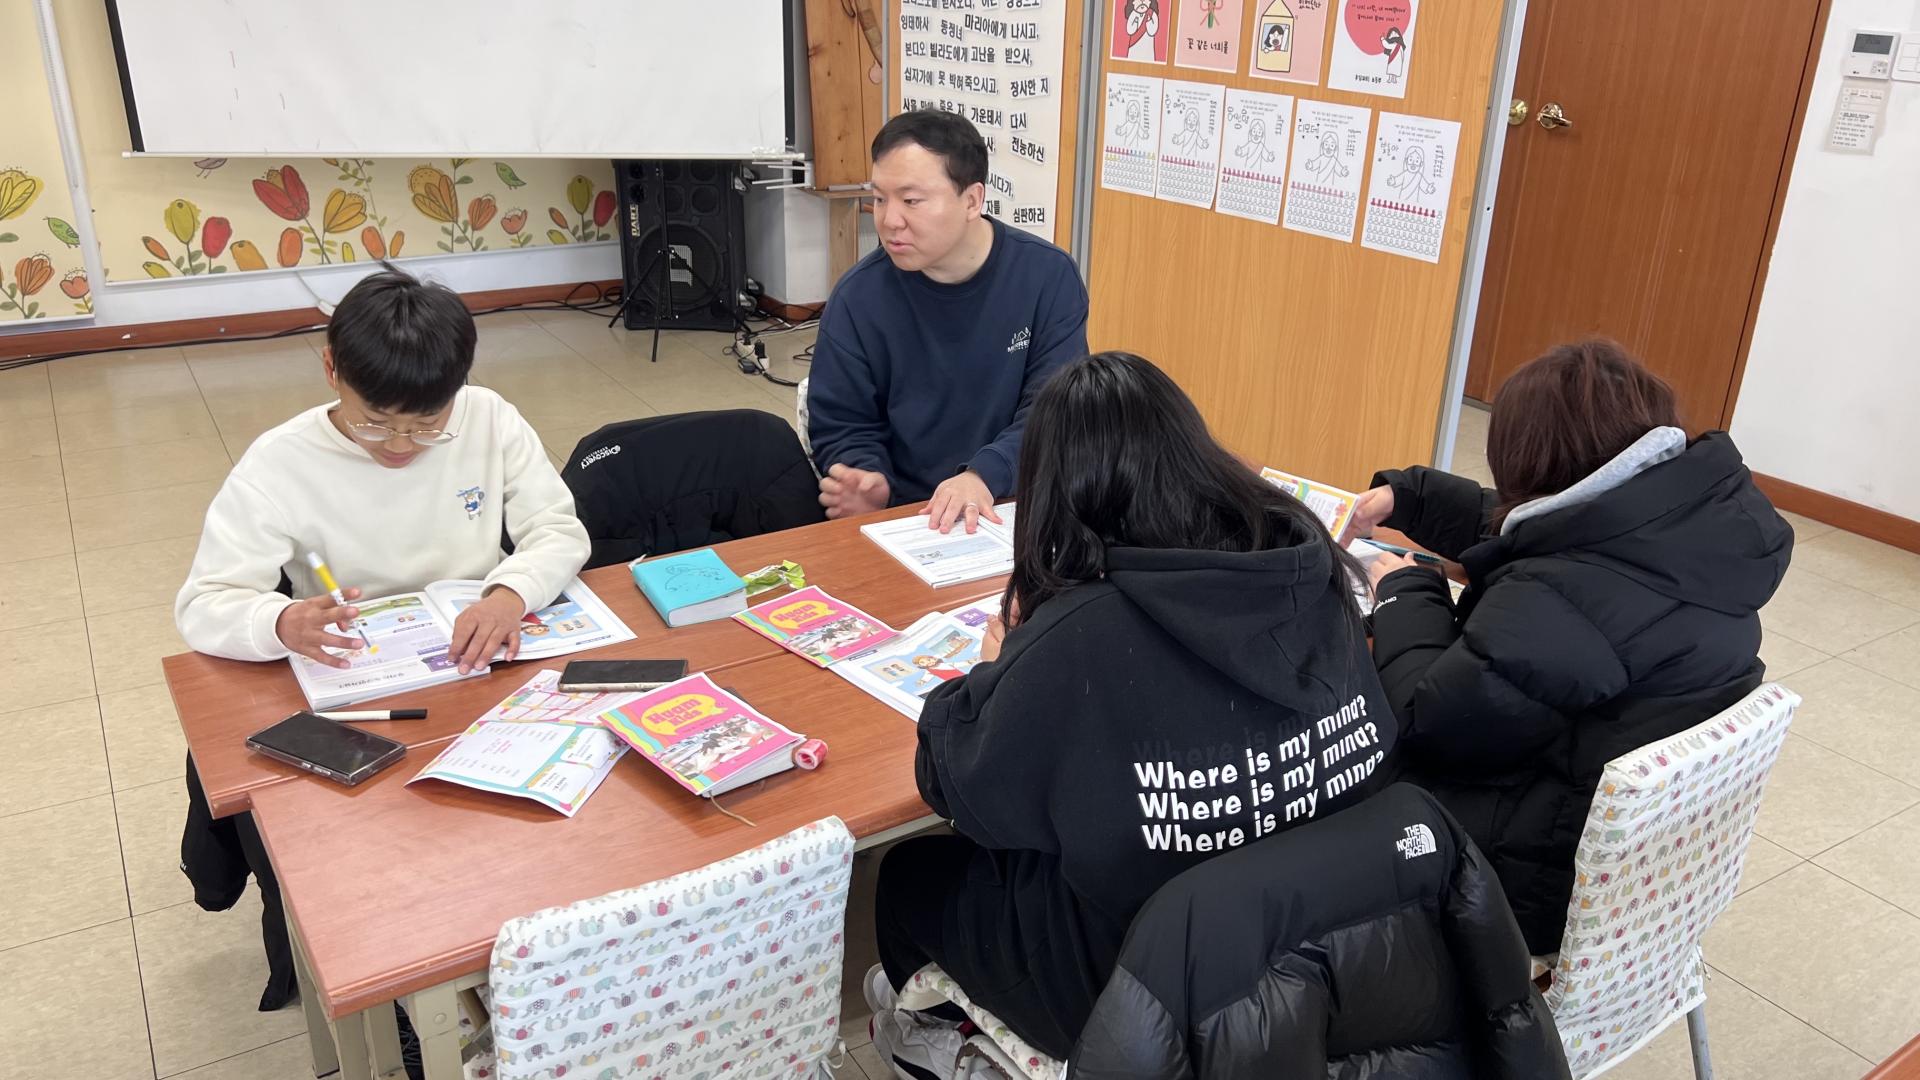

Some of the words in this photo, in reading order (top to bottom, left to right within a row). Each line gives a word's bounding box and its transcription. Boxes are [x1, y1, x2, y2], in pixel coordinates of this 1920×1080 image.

[940, 19, 963, 41] 동정녀
[964, 13, 1007, 39] 마리아에게
[1011, 22, 1039, 40] 나시고,
[905, 41, 925, 56] 본디오
[930, 42, 968, 62] 빌라도에게
[971, 46, 995, 63] 고난을
[1005, 47, 1032, 65] 받으사,
[904, 66, 933, 86] 십자가에
[938, 70, 946, 86] 못
[1010, 112, 1027, 129] 다시
[1012, 136, 1044, 163] 전능하신
[1013, 208, 1045, 223] 심판하러
[646, 699, 702, 724] Huam
[670, 710, 703, 725] Kids
[1134, 761, 1238, 790] Where
[1246, 747, 1272, 777] is
[1279, 729, 1311, 762] my
[1317, 694, 1367, 740] mind?
[1138, 791, 1242, 820] Where
[1250, 779, 1275, 807] is
[1283, 757, 1316, 792] my
[1322, 722, 1380, 769] mind?
[1142, 823, 1245, 852] Where
[1253, 811, 1277, 838] is
[1285, 788, 1319, 822] my
[1325, 750, 1385, 799] mind?
[1404, 824, 1420, 838] THE
[1396, 835, 1422, 852] NORTH
[1405, 844, 1423, 860] FACE
